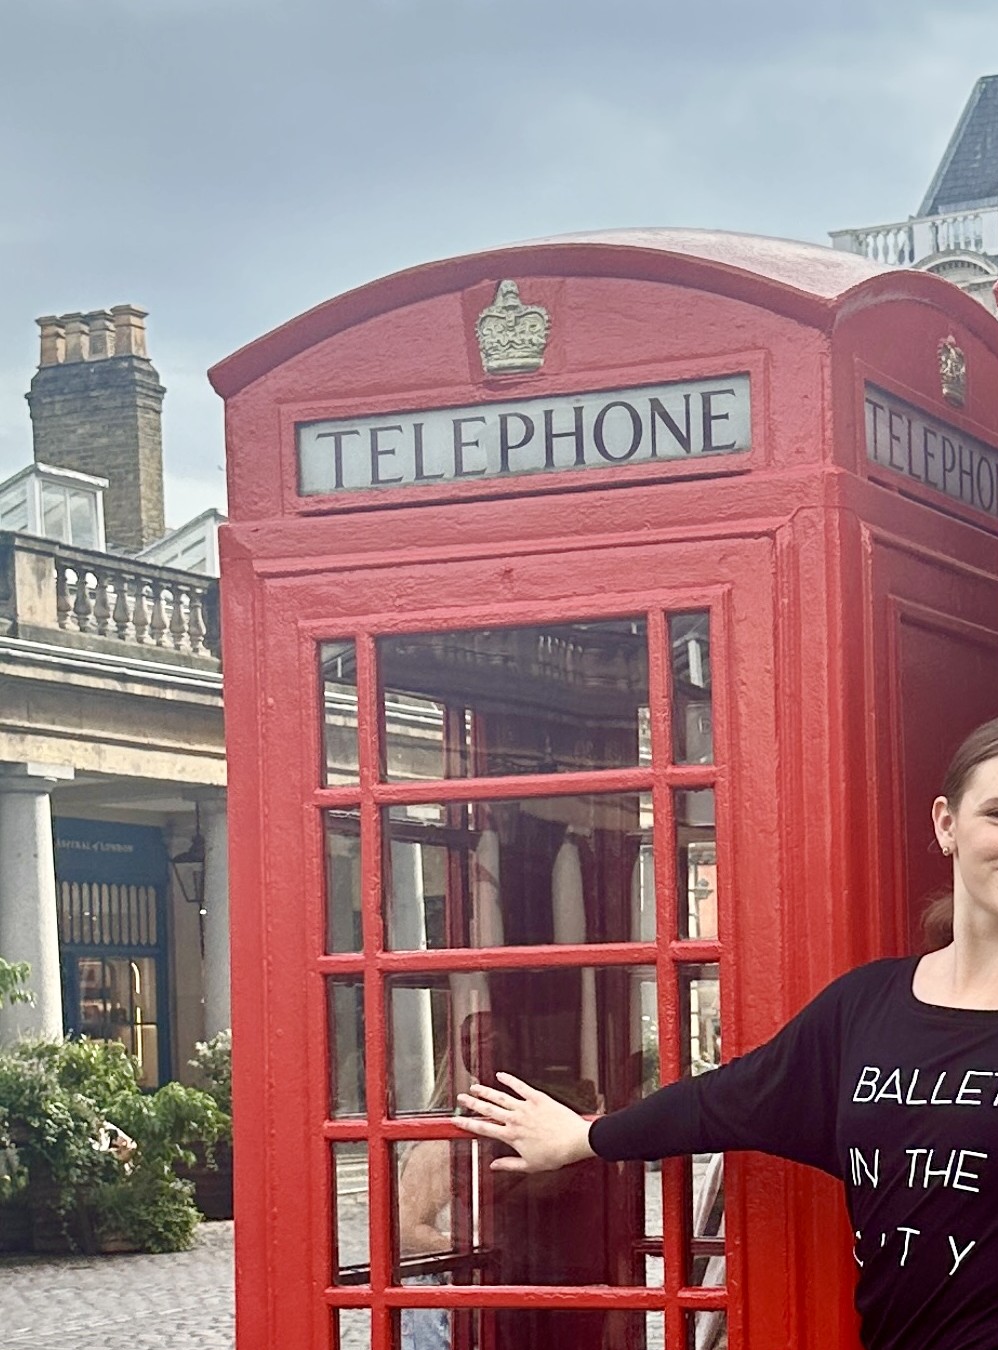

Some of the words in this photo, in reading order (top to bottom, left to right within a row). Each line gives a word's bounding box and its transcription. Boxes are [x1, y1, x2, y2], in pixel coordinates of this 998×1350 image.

[315, 388, 737, 490] TELEPHONE
[850, 1147, 880, 1188] IN
[906, 1148, 988, 1193] THE
